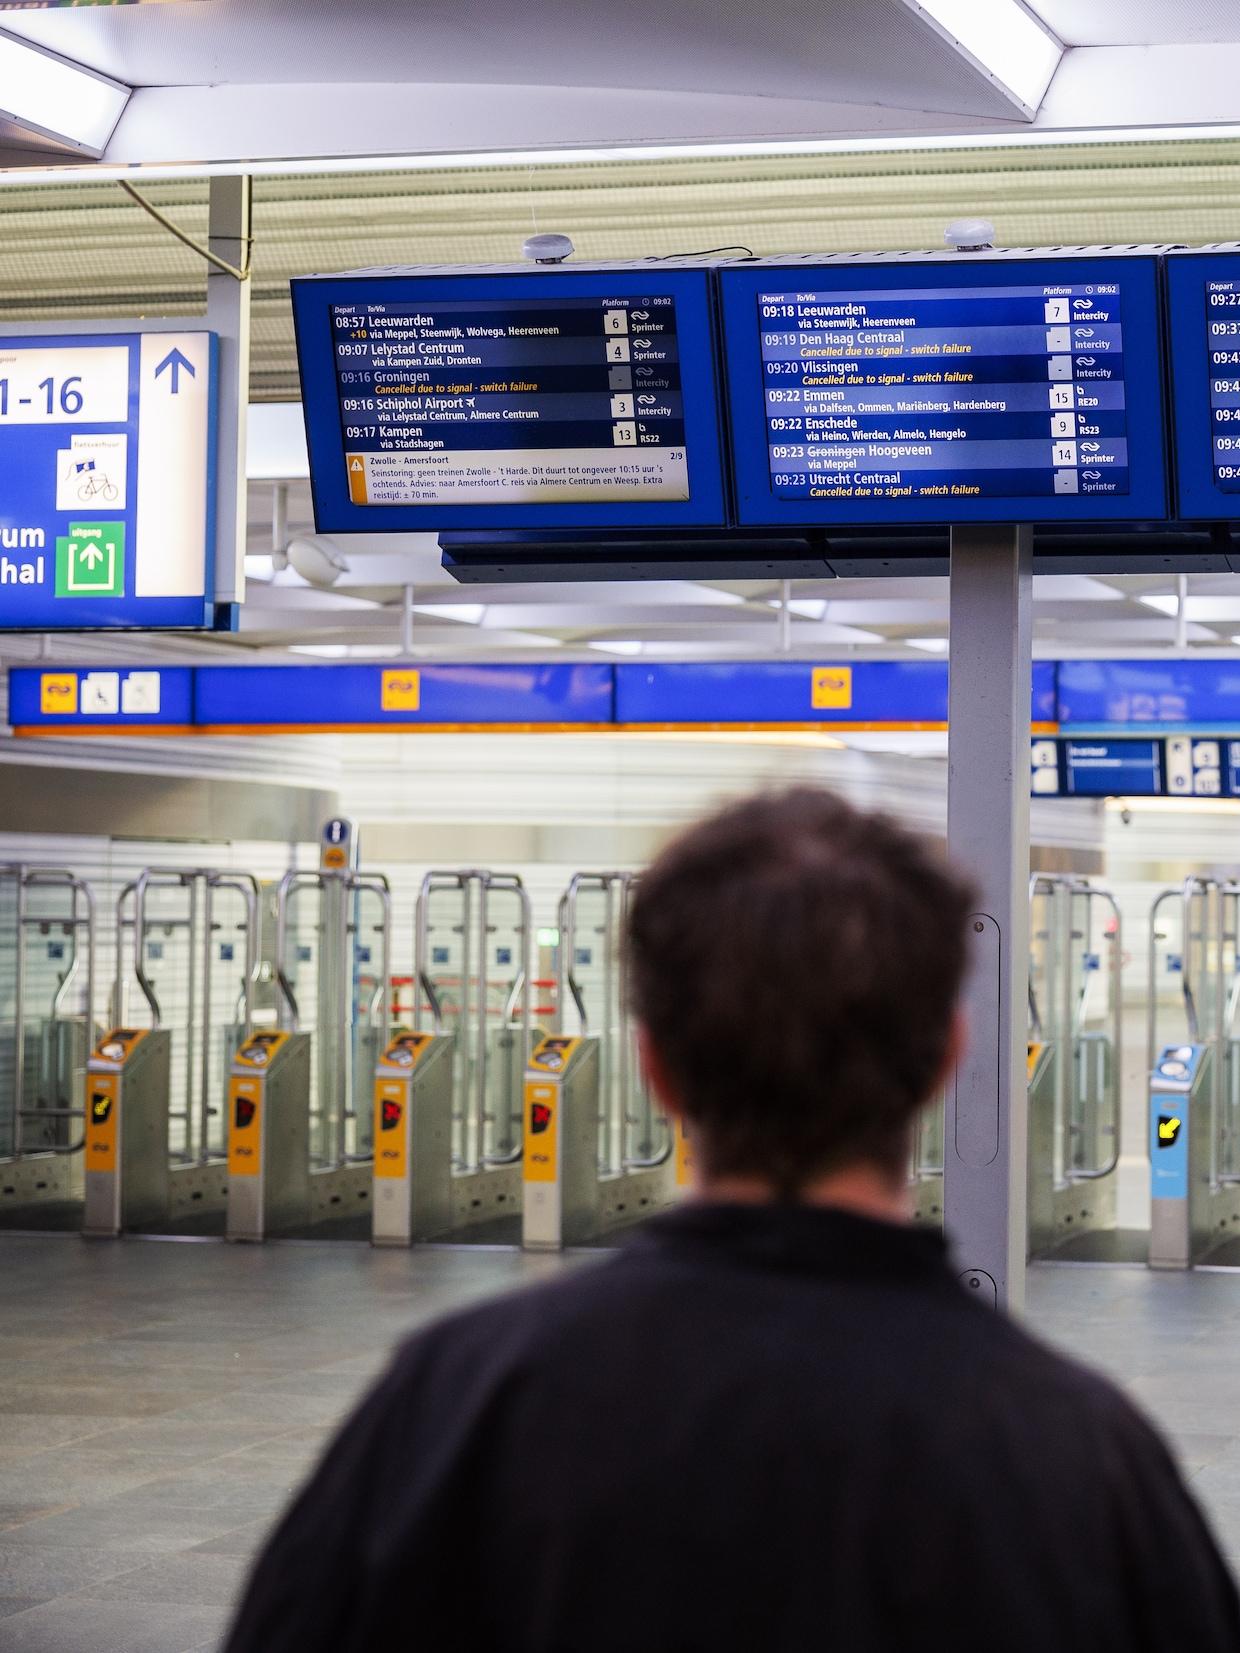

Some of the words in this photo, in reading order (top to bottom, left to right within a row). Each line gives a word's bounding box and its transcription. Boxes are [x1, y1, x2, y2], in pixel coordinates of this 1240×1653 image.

[601, 298, 630, 306] Platform
[653, 297, 672, 305] 09:02
[334, 306, 356, 315] Depart
[367, 305, 386, 313] To/Via
[762, 305, 795, 318] 09:18
[797, 302, 866, 317] Leeuwarden
[1053, 306, 1060, 318] 7
[1073, 310, 1109, 321] Intercity
[335, 316, 365, 328] 08:57
[368, 314, 434, 327] Leeuwarden
[612, 317, 619, 329] 6
[797, 318, 812, 329] via
[813, 317, 861, 330] Steenwijk,
[862, 317, 916, 327] Heerenveen
[350, 329, 367, 339] +10
[369, 329, 383, 339] via
[384, 328, 418, 341] Meppel,
[419, 327, 465, 339] Steenwijk,
[465, 327, 506, 338] Wolvega,
[508, 326, 559, 336] Heerenveen
[631, 322, 664, 333] Sprinter
[765, 334, 796, 346] 09:19
[799, 333, 822, 345] Den
[824, 332, 854, 348] Haag
[856, 330, 905, 344] Centraal
[1075, 339, 1111, 350] Intercity
[338, 344, 368, 356] 09:07
[371, 342, 416, 358] Lelystad
[418, 342, 465, 354] Centrum
[614, 346, 622, 357] 4
[633, 350, 666, 361] Sprinter
[371, 357, 386, 366] via
[387, 357, 422, 368] Kampen
[423, 355, 445, 366] Zuid,
[446, 356, 482, 365] Dronten
[766, 362, 798, 374] 09:20
[800, 360, 858, 375] Vlissingen
[341, 372, 371, 383] 09:16
[373, 370, 430, 385] Groningen
[1076, 368, 1112, 379] Intercity
[374, 382, 416, 394] Cancelled
[417, 384, 434, 393] due
[435, 384, 446, 393] to
[446, 382, 473, 395] signal
[480, 382, 508, 392] switch
[509, 381, 538, 391] failure
[635, 378, 669, 388] Intercity
[768, 390, 800, 402] 09:22
[803, 389, 845, 401] Emmen
[1055, 392, 1068, 404] 15
[1077, 397, 1099, 406] RE20
[343, 399, 374, 410] 09:16
[376, 397, 422, 412] Schiphol
[424, 397, 464, 411] Airport
[619, 401, 626, 413] 3
[803, 403, 818, 413] via
[819, 402, 856, 413] Dalfsen,
[857, 402, 895, 413] Ommen,
[896, 400, 951, 413] Mariënberg,
[953, 399, 1006, 411] Hardenberg
[377, 411, 391, 421] via
[392, 411, 428, 423] Lelystad
[429, 411, 468, 421] Centrum,
[469, 410, 501, 420] Almere
[502, 410, 539, 419] Centrum
[637, 406, 672, 417] Intercity
[770, 418, 803, 430] 09:22
[805, 416, 858, 429] Enschede
[1059, 421, 1067, 432] 9
[346, 426, 376, 438] 09:17
[378, 425, 423, 440] Kampen
[618, 429, 631, 440] 13
[805, 431, 820, 441] via
[821, 430, 850, 441] Heino,
[851, 429, 891, 441] Wierden,
[893, 428, 927, 440] Almelo,
[929, 428, 967, 440] Hengelo
[1079, 425, 1100, 435] RS23
[379, 441, 393, 449] via
[394, 438, 444, 450] Stadshagen
[640, 434, 660, 443] RS22
[670, 452, 683, 460] 2/9
[772, 446, 804, 458] 09:23
[868, 444, 932, 459] Hoogeveen
[1058, 449, 1071, 460] 14
[369, 456, 397, 465] Zwolle
[403, 455, 449, 464] Amersfoort
[807, 459, 822, 469] via
[823, 458, 857, 471] Meppel
[1080, 453, 1115, 464] Sprinter
[371, 469, 416, 479] Seinstoring:
[417, 470, 436, 479] geen
[466, 467, 491, 476] Zwolle
[505, 467, 531, 475] Harde.
[532, 466, 544, 475] Dit
[545, 466, 566, 475] duurt
[567, 466, 580, 474] tot
[581, 467, 617, 476] ongeveer
[619, 465, 640, 473] 10:15
[372, 479, 408, 488] ochtends.
[409, 479, 437, 487] Advies:
[457, 478, 500, 487] Amersfoort
[501, 478, 509, 486] C.
[526, 477, 538, 486] via
[539, 477, 567, 486] Almere
[568, 477, 601, 485] Centrum
[613, 476, 641, 486] Weesp.
[642, 476, 663, 484] Extra
[774, 474, 806, 486] 09:23
[809, 472, 851, 485] Utrecht
[853, 471, 901, 484] Centraal
[1082, 482, 1116, 492] Sprinter
[373, 490, 402, 501] reistijd:
[411, 490, 421, 499] 70
[0, 527, 45, 548] um
